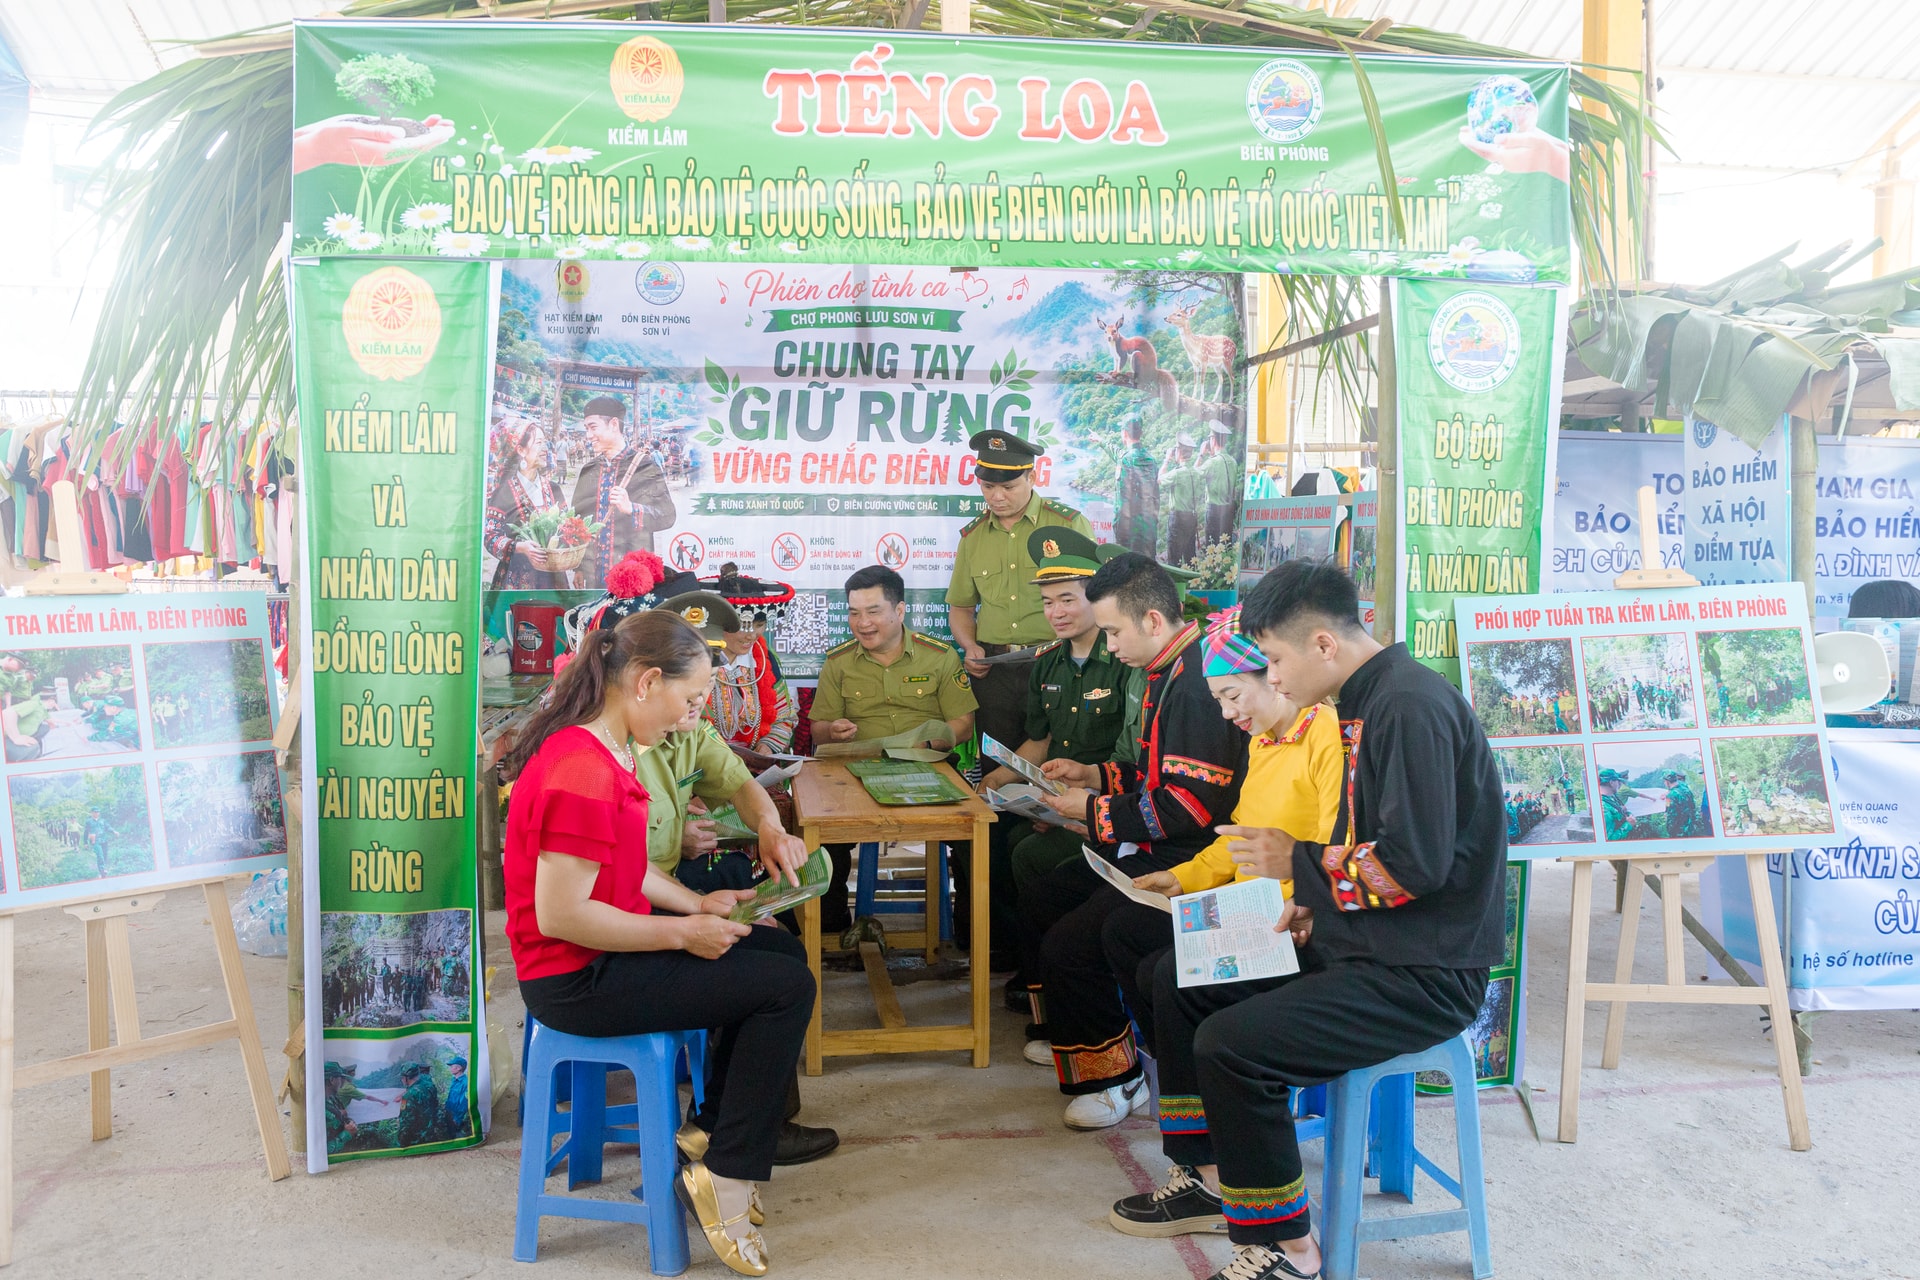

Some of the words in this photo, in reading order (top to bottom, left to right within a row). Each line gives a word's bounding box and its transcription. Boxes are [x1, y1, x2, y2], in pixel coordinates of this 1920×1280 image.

[764, 43, 1001, 140] TIẾNG
[1018, 76, 1169, 146] LOA
[608, 122, 649, 145] KIỂM
[654, 126, 688, 146] LÂM
[1240, 143, 1275, 160] BIÊN
[1279, 144, 1329, 161] PHÒNG
[511, 162, 544, 248] VỆ
[550, 162, 622, 235] RỪNG
[627, 164, 659, 236] LÀ
[664, 157, 717, 236] BẢO
[721, 165, 754, 250] VỆ
[761, 166, 828, 250] CUỘC
[834, 159, 909, 246] SỐNG,
[914, 161, 966, 240] BẢO
[970, 171, 1002, 252] VỆ
[1006, 172, 1064, 242] BIÊN
[1070, 175, 1119, 243] GIỚI
[1125, 175, 1155, 244] LÀ
[1159, 169, 1206, 245] BẢO
[1212, 177, 1242, 258] VỆ
[1246, 167, 1277, 248] TỔ
[1280, 171, 1341, 255] QUỐC
[1345, 183, 1392, 264] VIỆT
[744, 269, 823, 307] Phiên
[827, 271, 868, 304] chợ
[871, 269, 918, 299] tình
[921, 279, 949, 297] ca
[544, 314, 560, 325] HẠT
[562, 311, 583, 322] KIỂM
[547, 326, 564, 334] KHU
[567, 326, 584, 336] VỰC
[642, 313, 660, 324] BIÊN
[663, 313, 690, 324] PHÒNG
[642, 327, 659, 336] SƠN
[790, 312, 816, 327] CHỢ
[820, 312, 862, 325] PHONG
[865, 310, 889, 324] LƯU
[893, 311, 918, 325] SƠN
[921, 311, 936, 326] VĨ
[394, 341, 422, 356] LÂM
[773, 340, 900, 380] CHUNG
[910, 343, 975, 381] TAY
[324, 392, 394, 453] KIỂM
[400, 402, 457, 454] LÂM
[729, 380, 845, 442] GIỮ
[857, 382, 1032, 445] RỪNG
[1434, 412, 1465, 469] BỘ
[1469, 414, 1504, 470] ĐỘI
[712, 446, 792, 485] VỮNG
[800, 443, 877, 485] CHẮC
[885, 448, 951, 486] BIÊN
[1692, 461, 1726, 488] BẢO
[1732, 450, 1777, 484] HIỂM
[372, 475, 407, 527] VÀ
[721, 497, 744, 510] RỪNG
[745, 500, 767, 510] XANH
[782, 497, 805, 510] QUỐC
[1870, 477, 1914, 499] GIA
[844, 498, 863, 510] BIÊN
[864, 499, 892, 510] CƯƠNG
[917, 498, 938, 511] CHẮC
[1406, 479, 1454, 527] BIÊN
[1457, 479, 1524, 529] PHÒNG
[1575, 503, 1631, 534] BẢO
[1702, 500, 1725, 525] XÃ
[1731, 496, 1765, 528] HỘI
[1815, 508, 1867, 538] BẢO
[708, 536, 734, 545] KHÔNG
[809, 536, 835, 545] KHÔNG
[912, 537, 937, 546] KHÔNG
[1694, 531, 1733, 562] ĐIỂM
[1739, 537, 1775, 567] TỰA
[1426, 546, 1481, 594] NHÂN
[1483, 547, 1529, 594] DÂN
[1591, 542, 1643, 573] CỦA
[1834, 546, 1892, 578] ĐÌNH
[320, 549, 395, 600] NHÂN
[402, 549, 458, 601] DÂN
[828, 601, 845, 610] QUÉT
[912, 603, 925, 613] TAY
[926, 602, 945, 613] CÙNG
[1474, 604, 1509, 630] PHỐI
[1513, 608, 1542, 632] HỢP
[1545, 601, 1584, 627] TUẦN
[1587, 605, 1615, 625] TRA
[1617, 597, 1656, 623] KIỂM
[1659, 600, 1696, 622] LÂM,
[1699, 598, 1734, 620] BIÊN
[1737, 594, 1788, 618] PHÒNG
[1830, 592, 1843, 604] xã
[4, 614, 42, 635] TRA
[46, 605, 94, 634] KIỂM
[99, 607, 143, 633] LÂM,
[147, 605, 188, 630] BIÊN
[191, 603, 248, 628] PHÒNG
[828, 613, 840, 622] TÌM
[828, 625, 846, 635] PHÁP
[912, 616, 922, 627] VÀ
[923, 616, 933, 628] BỘ
[934, 616, 947, 628] ĐỘI
[313, 616, 386, 673] ĐỒNG
[392, 621, 464, 675] LÒNG
[1414, 611, 1460, 659] ĐOÀN
[340, 690, 394, 746] BẢO
[400, 696, 435, 757] VỆ
[358, 768, 465, 820] NGUYÊN
[1865, 802, 1899, 811] QUANG
[1870, 815, 1889, 825] VẠC
[350, 841, 423, 893] RỪNG
[1804, 836, 1898, 880] CHÍNH
[1802, 953, 1821, 972] hệ
[1826, 949, 1851, 968] số
[1852, 951, 1914, 968] hotline
